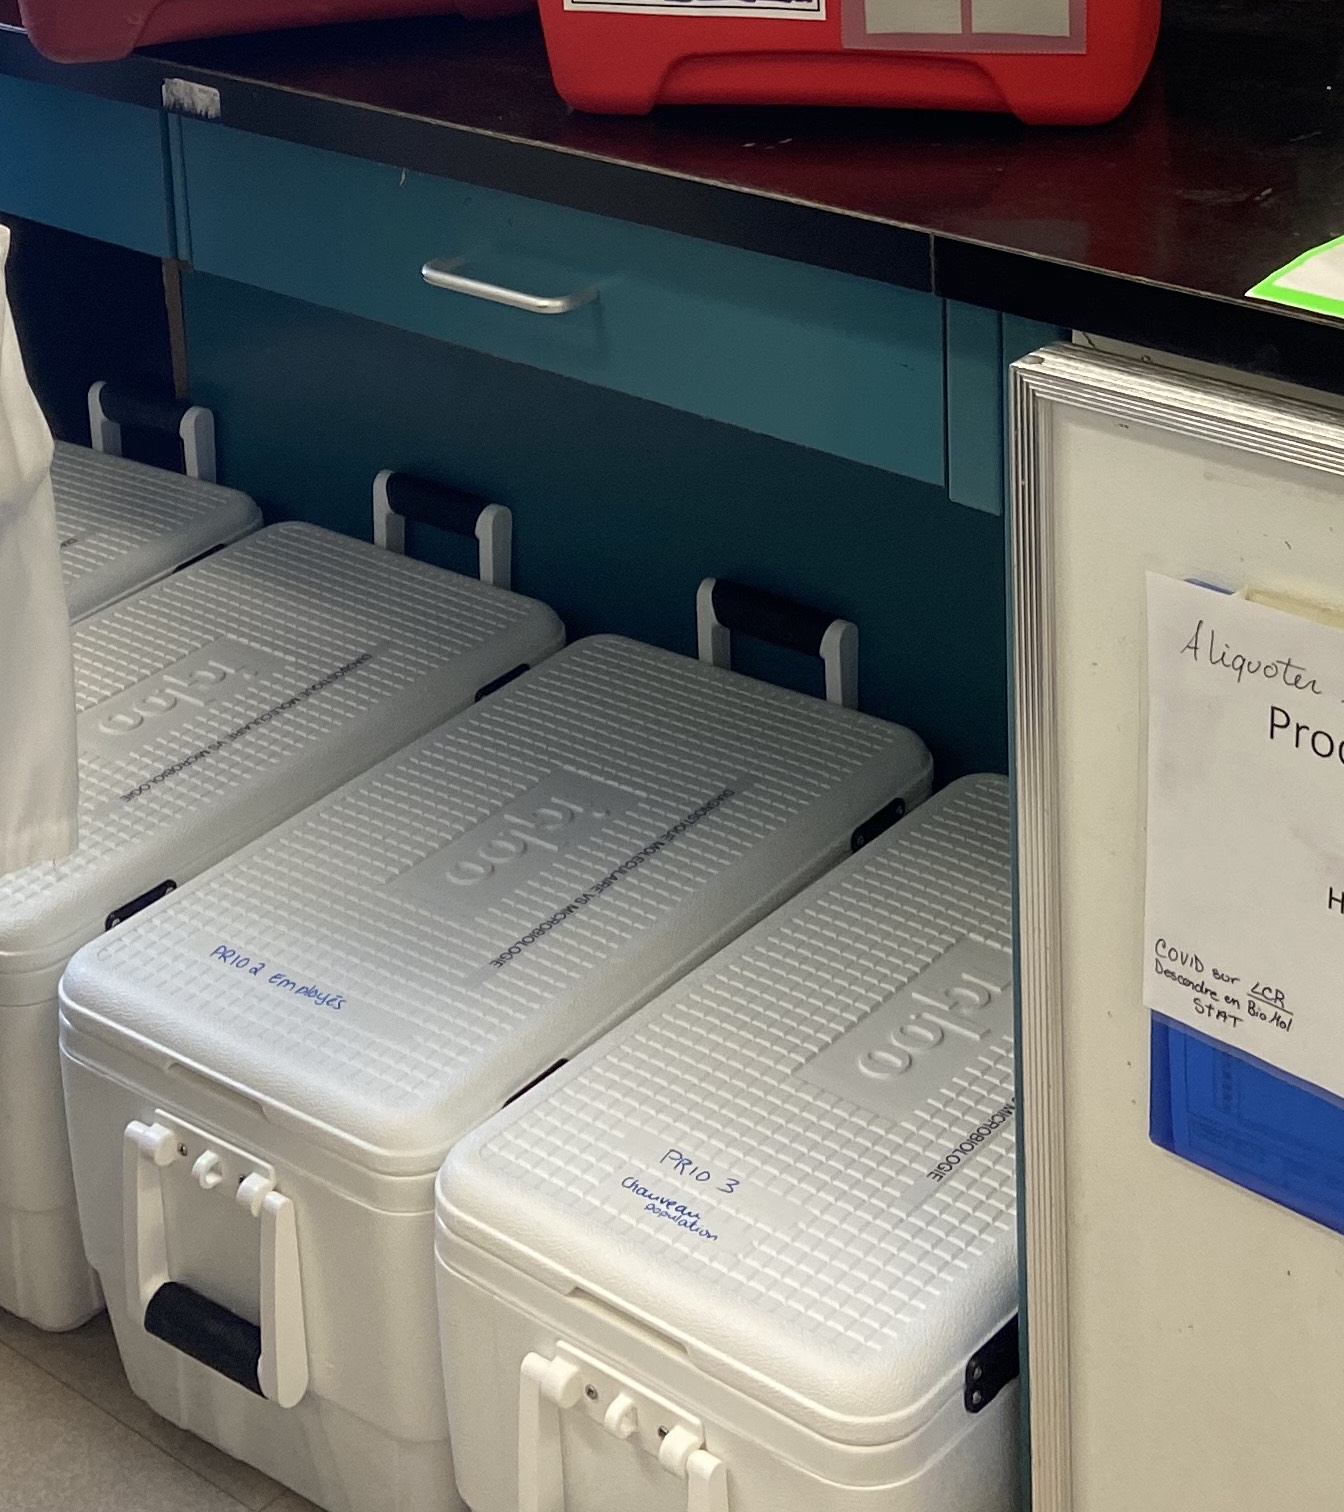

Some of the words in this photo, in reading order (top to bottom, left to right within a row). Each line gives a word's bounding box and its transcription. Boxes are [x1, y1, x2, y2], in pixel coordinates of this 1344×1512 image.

[1180, 619, 1323, 696] Aliquoter
[590, 839, 668, 894] MOLECULAIRE
[209, 945, 250, 970] PRIO
[488, 903, 579, 969] MICROBIOLOGIE
[1154, 938, 1205, 973] COVID
[1211, 967, 1241, 985] sur
[1250, 981, 1286, 1010] LCR
[1154, 957, 1220, 1003] Descendre
[1224, 994, 1241, 1010] en
[659, 1148, 711, 1182] PRIO
[716, 1177, 740, 1194] 3
